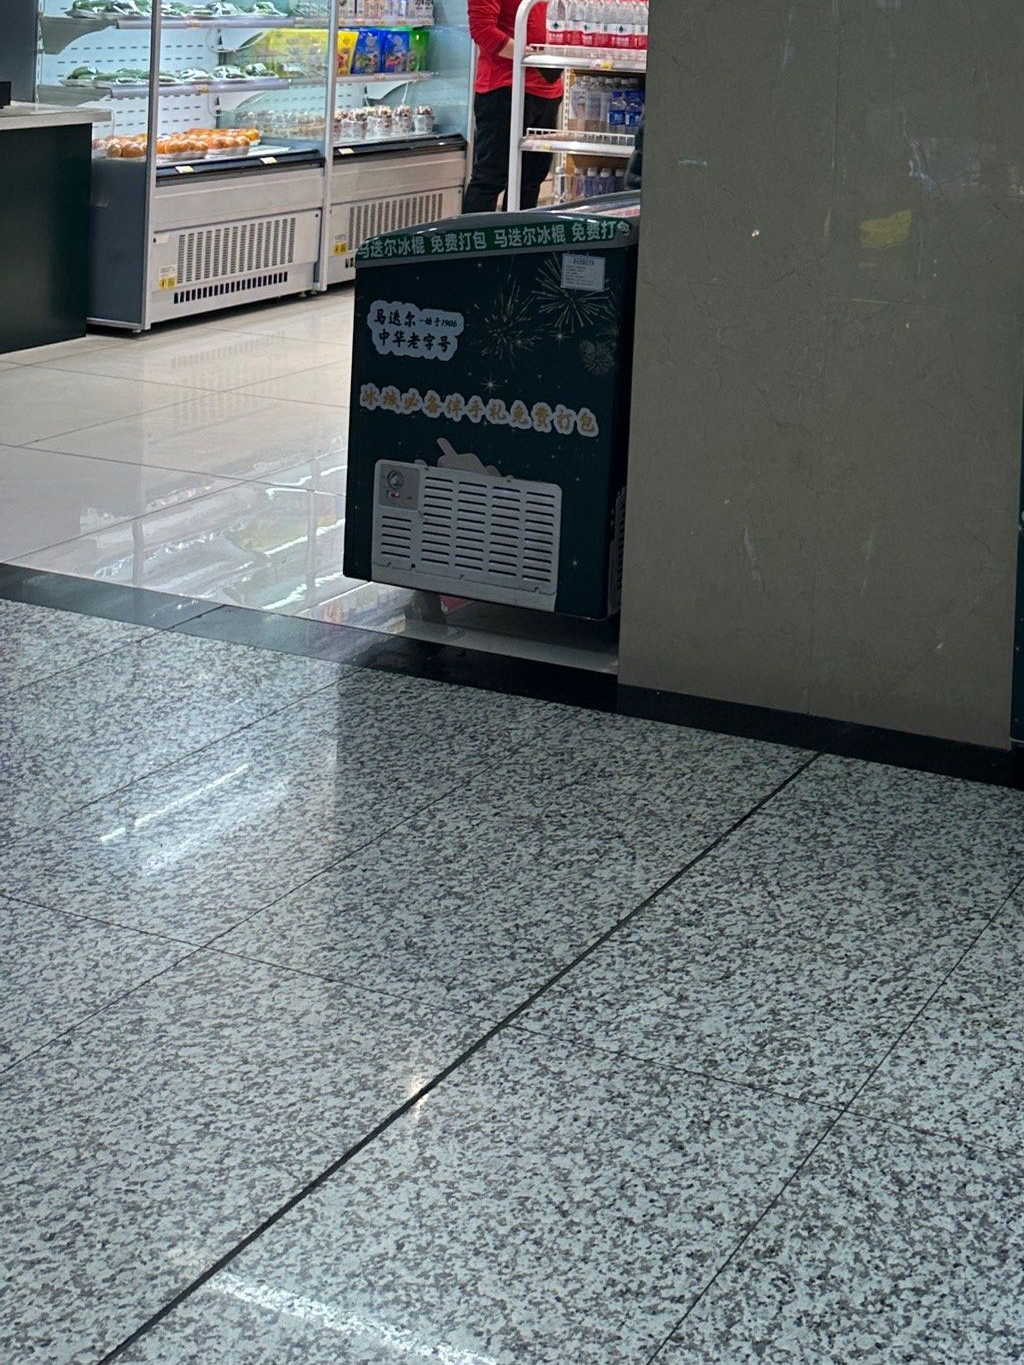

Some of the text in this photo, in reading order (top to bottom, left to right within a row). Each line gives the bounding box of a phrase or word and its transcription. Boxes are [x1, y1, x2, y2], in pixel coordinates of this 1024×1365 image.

[358, 235, 426, 259] 马迭尔冰棍
[431, 231, 487, 254] 免费打包
[494, 223, 566, 248] 马迭尔冰棍
[379, 328, 451, 353] 中华老字号
